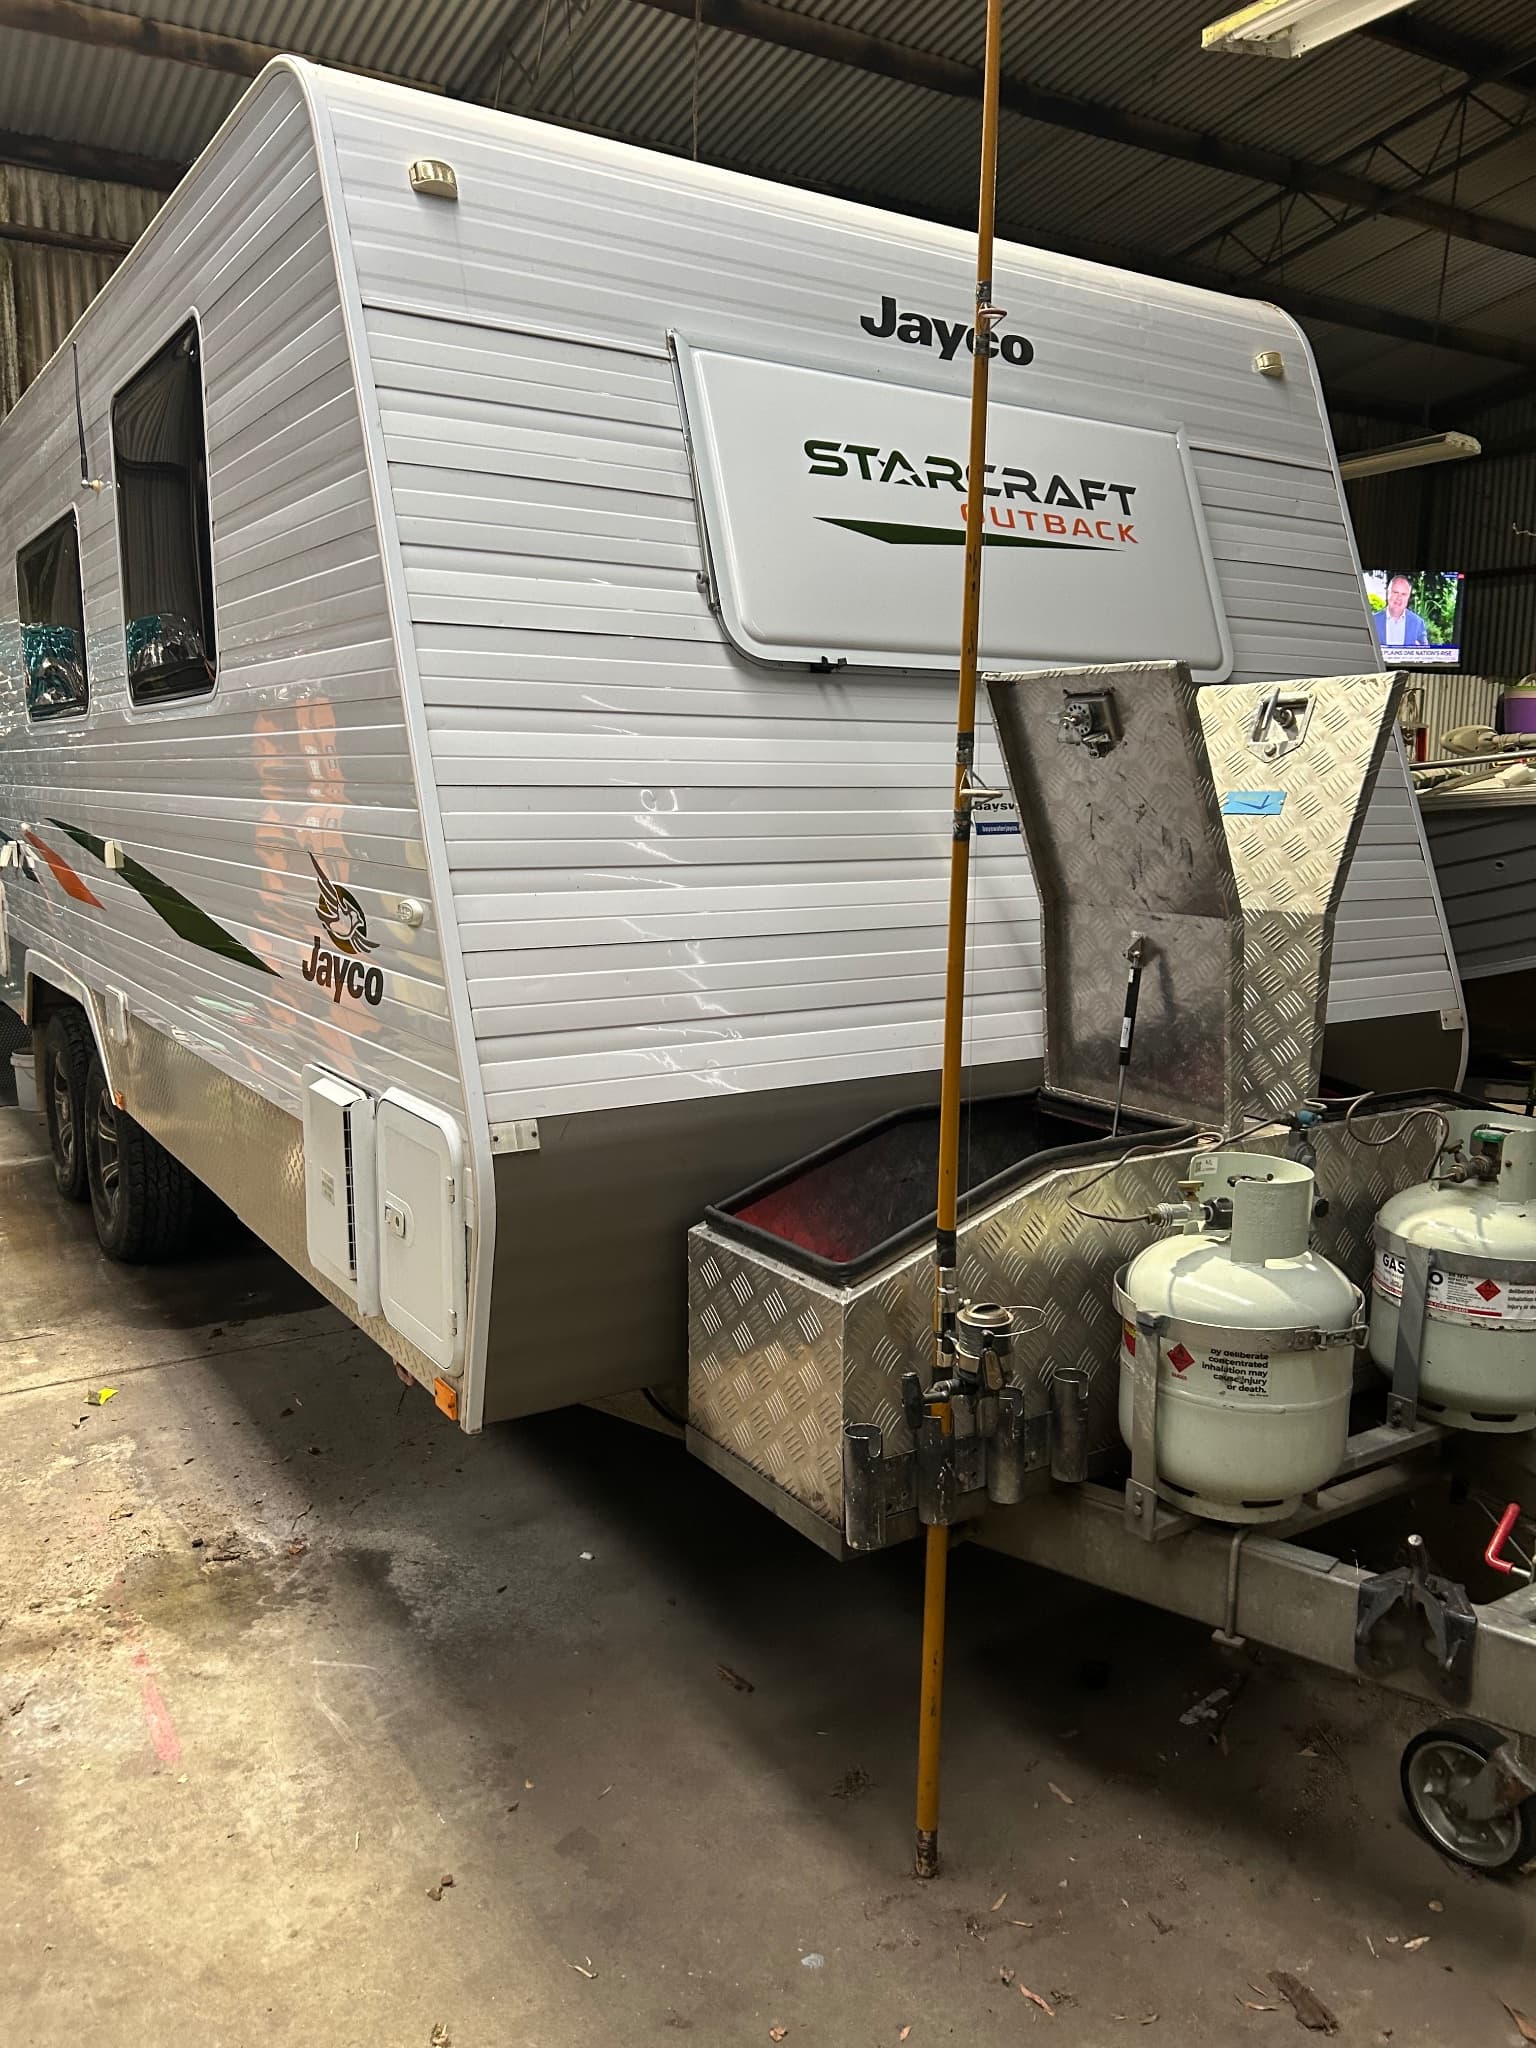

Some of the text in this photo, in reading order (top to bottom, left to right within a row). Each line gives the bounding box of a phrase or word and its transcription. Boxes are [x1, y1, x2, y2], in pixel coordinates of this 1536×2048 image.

[860, 295, 1034, 366] Jayco
[803, 439, 1137, 516] STARCRAFT
[302, 936, 384, 1006] Jayco
[1201, 1361, 1268, 1378] inhalation may
[1208, 1356, 1269, 1368] concentrated
